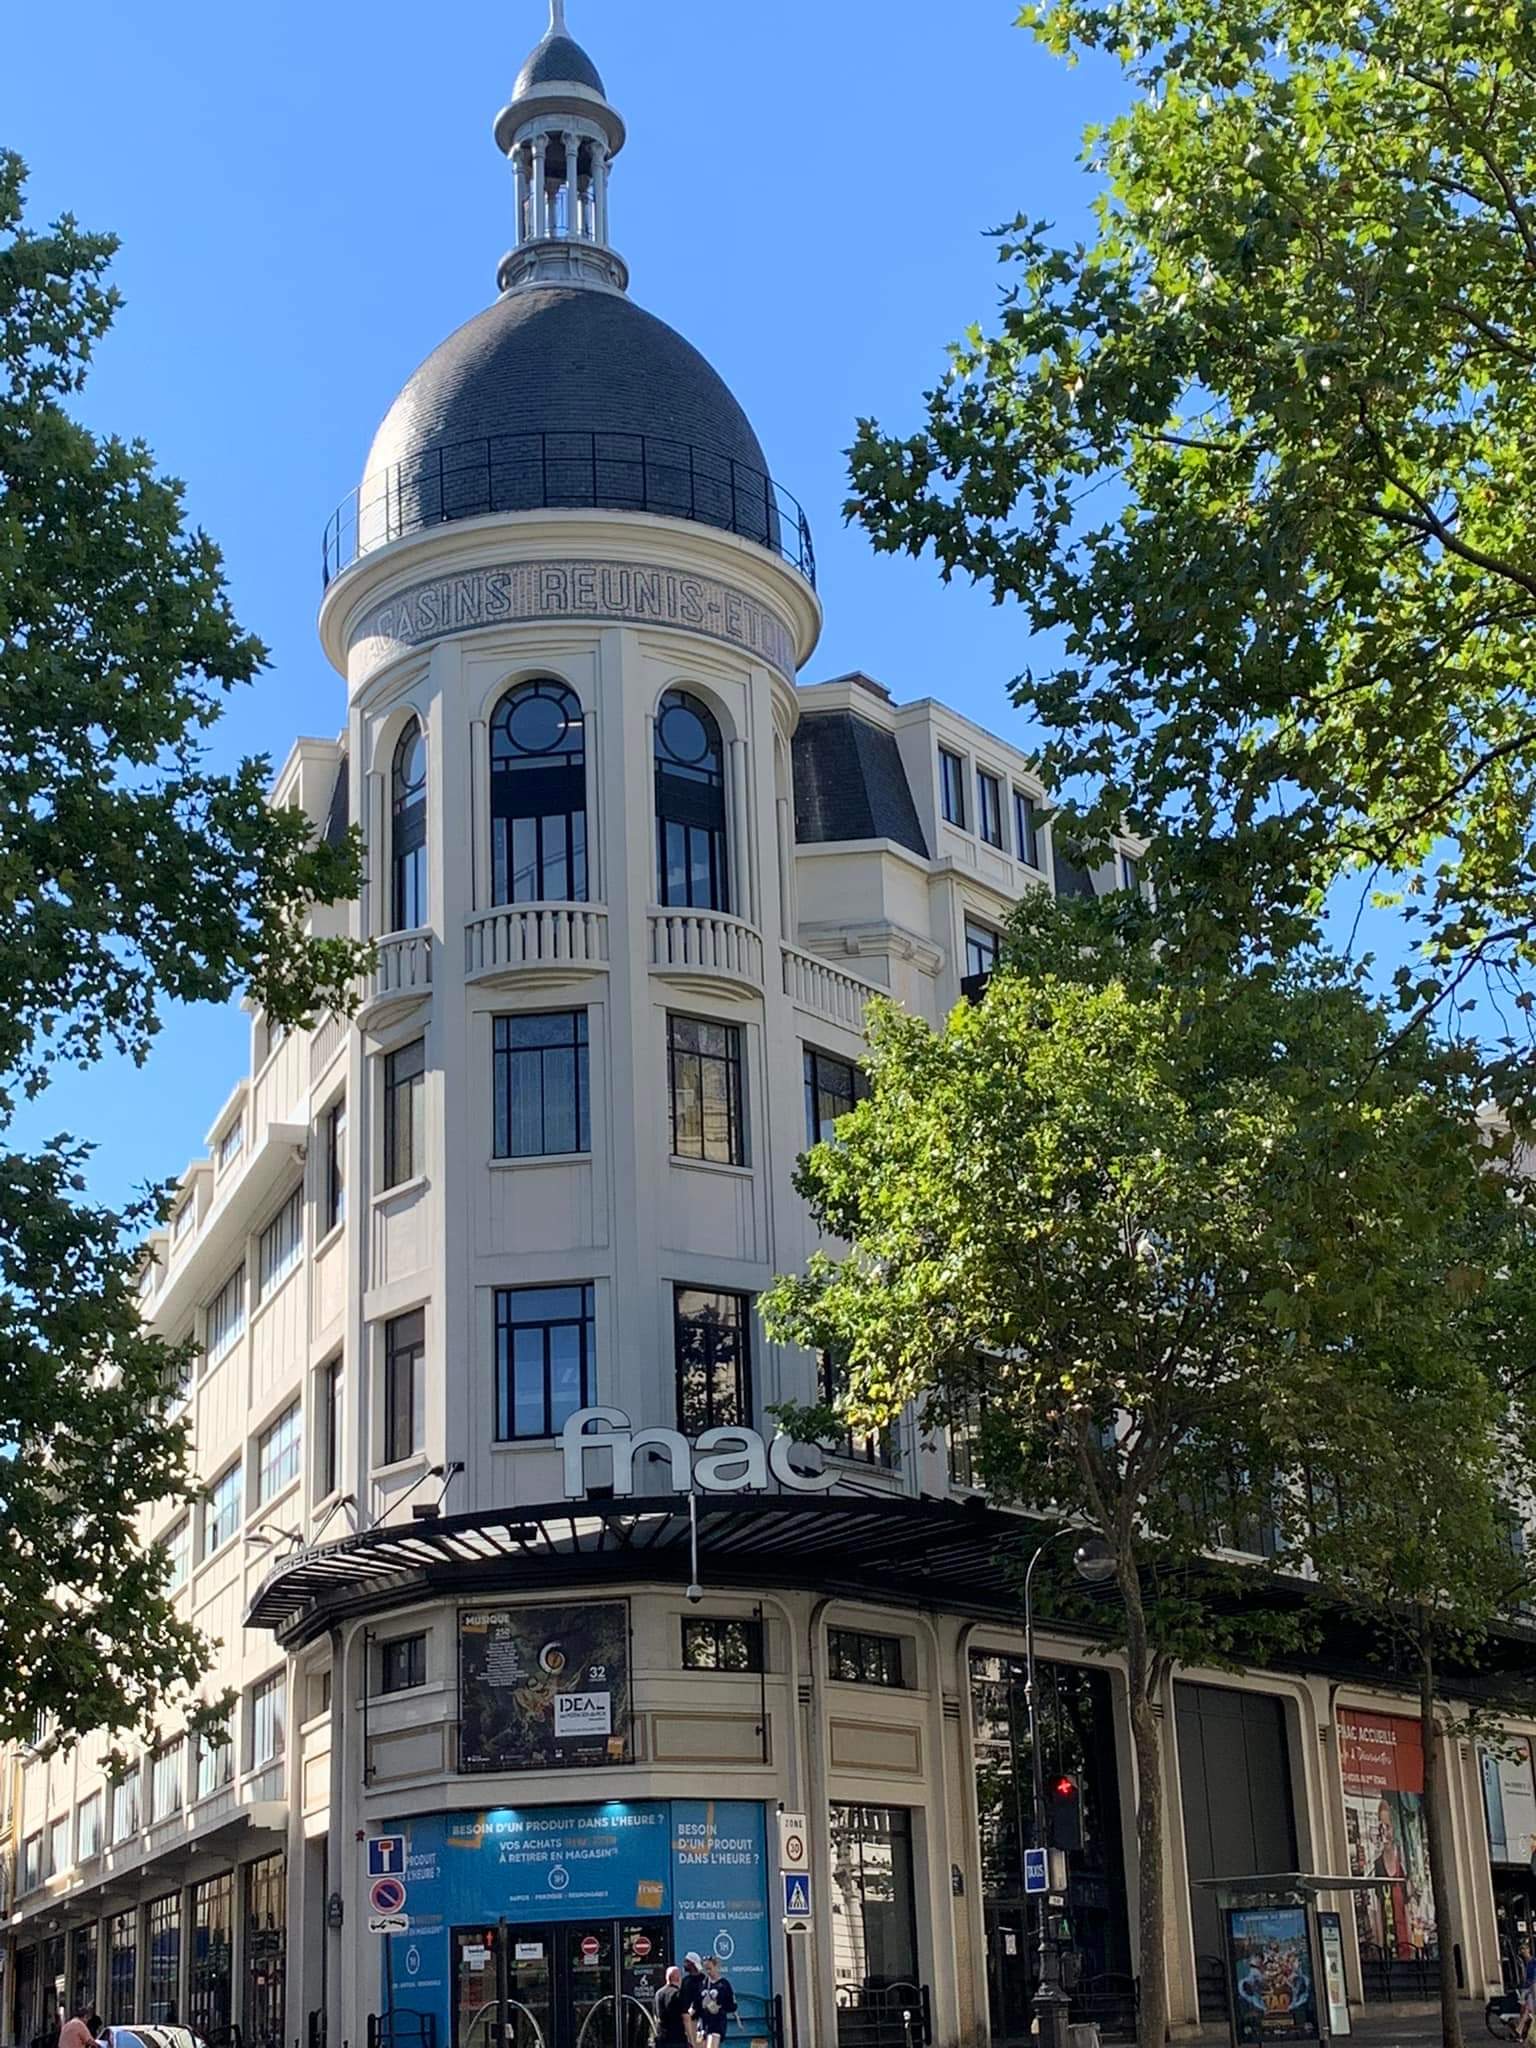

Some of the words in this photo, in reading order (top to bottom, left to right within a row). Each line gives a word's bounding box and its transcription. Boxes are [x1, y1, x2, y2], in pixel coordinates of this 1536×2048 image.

[554, 1406, 843, 1499] fnac
[465, 1613, 511, 1626] MUSIQUE
[589, 1665, 606, 1678] 32
[452, 1823, 493, 1836] BESOIN
[495, 1821, 524, 1834] D'UN
[526, 1819, 575, 1831] PRODUIT
[578, 1817, 609, 1829] DANS
[611, 1815, 656, 1827] L'HEURE
[657, 1814, 665, 1825] ?
[678, 1823, 717, 1836] BESOIN
[785, 1819, 803, 1829] ZONE
[500, 1840, 520, 1851] VOS
[522, 1838, 561, 1850] ACHATS
[679, 1838, 705, 1850] D'UN
[708, 1839, 753, 1850] PRODUIT
[790, 1842, 800, 1854] 30
[508, 1851, 548, 1863] RETIRER
[550, 1850, 563, 1861] EN
[679, 1854, 709, 1865] DANS
[711, 1853, 752, 1865] L'HEURE
[753, 1854, 760, 1865] ?
[1027, 1864, 1044, 1878] TAXIS
[678, 1900, 695, 1910] VOS
[696, 1899, 726, 1910] ACHATS
[686, 1911, 716, 1921] RETIRER
[717, 1911, 726, 1920] EN
